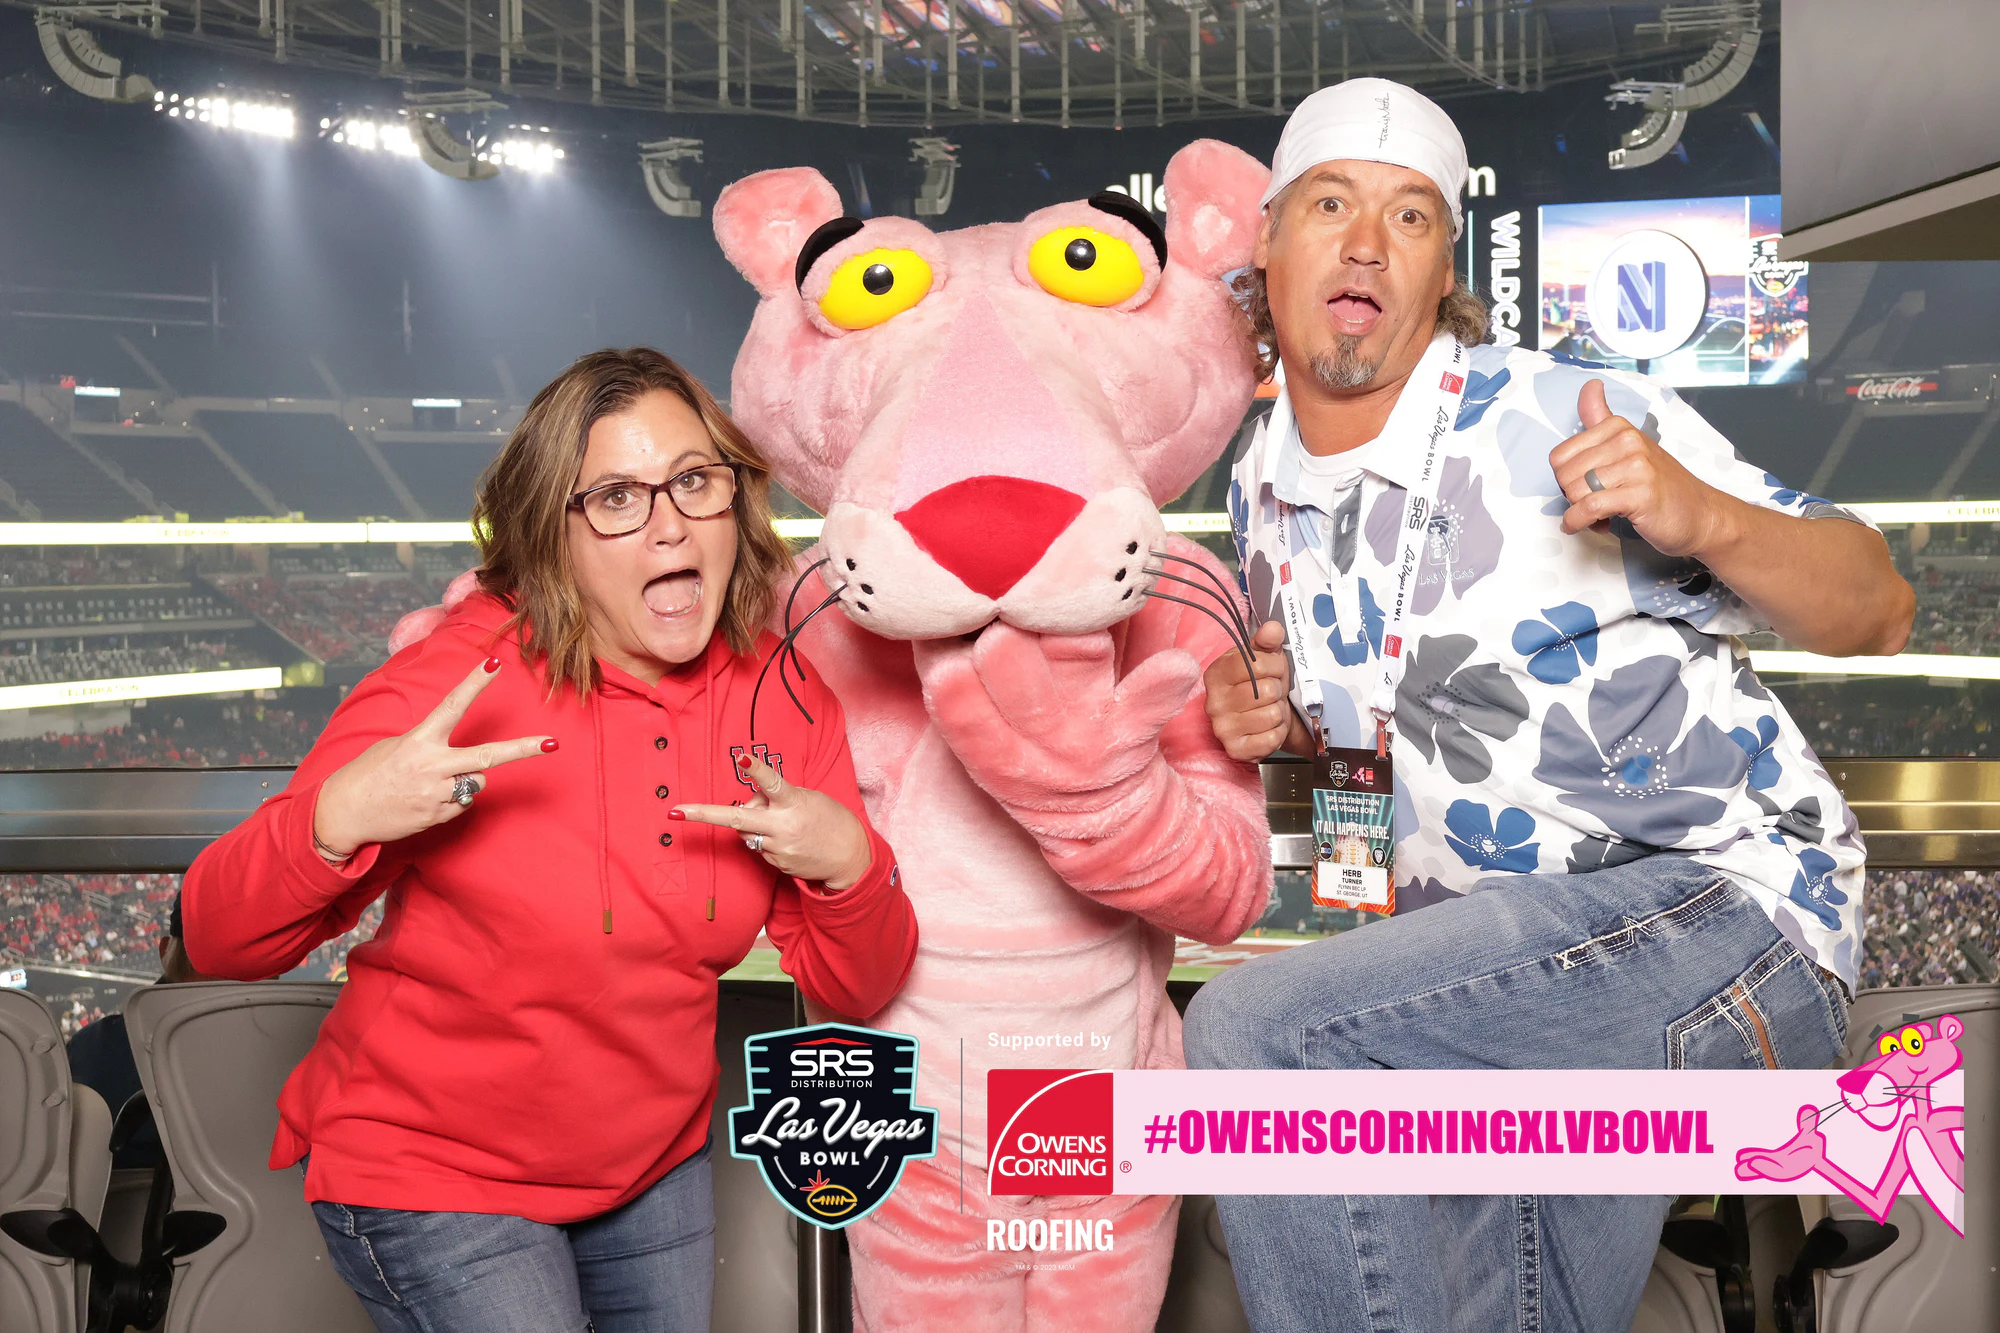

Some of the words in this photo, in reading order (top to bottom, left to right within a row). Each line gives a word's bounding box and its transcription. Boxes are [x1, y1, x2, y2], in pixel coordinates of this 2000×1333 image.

[1490, 210, 1522, 347] WILDCA
[1617, 260, 1666, 333] N
[1436, 405, 1449, 424] Las
[1428, 424, 1446, 450] Vegas
[1421, 452, 1435, 482] BOWL
[1409, 496, 1425, 531] SRS
[1404, 544, 1415, 564] Las
[1397, 564, 1413, 590] Vegas
[1288, 595, 1298, 624] BOWL
[1393, 592, 1405, 622] BOWL
[1293, 626, 1304, 652] Vegas
[1297, 652, 1308, 669] Las
[1325, 795, 1337, 803] SRS
[1338, 796, 1380, 806] DISTRIBUTION
[1339, 805, 1359, 813] VEGAS
[1360, 807, 1378, 815] BOWL
[1316, 820, 1323, 833] IT
[1323, 821, 1336, 834] ALL
[1337, 822, 1369, 838] HAPPENS
[1370, 825, 1390, 840] HERE.
[1341, 877, 1363, 885] TURNER
[1342, 868, 1362, 878] HERB
